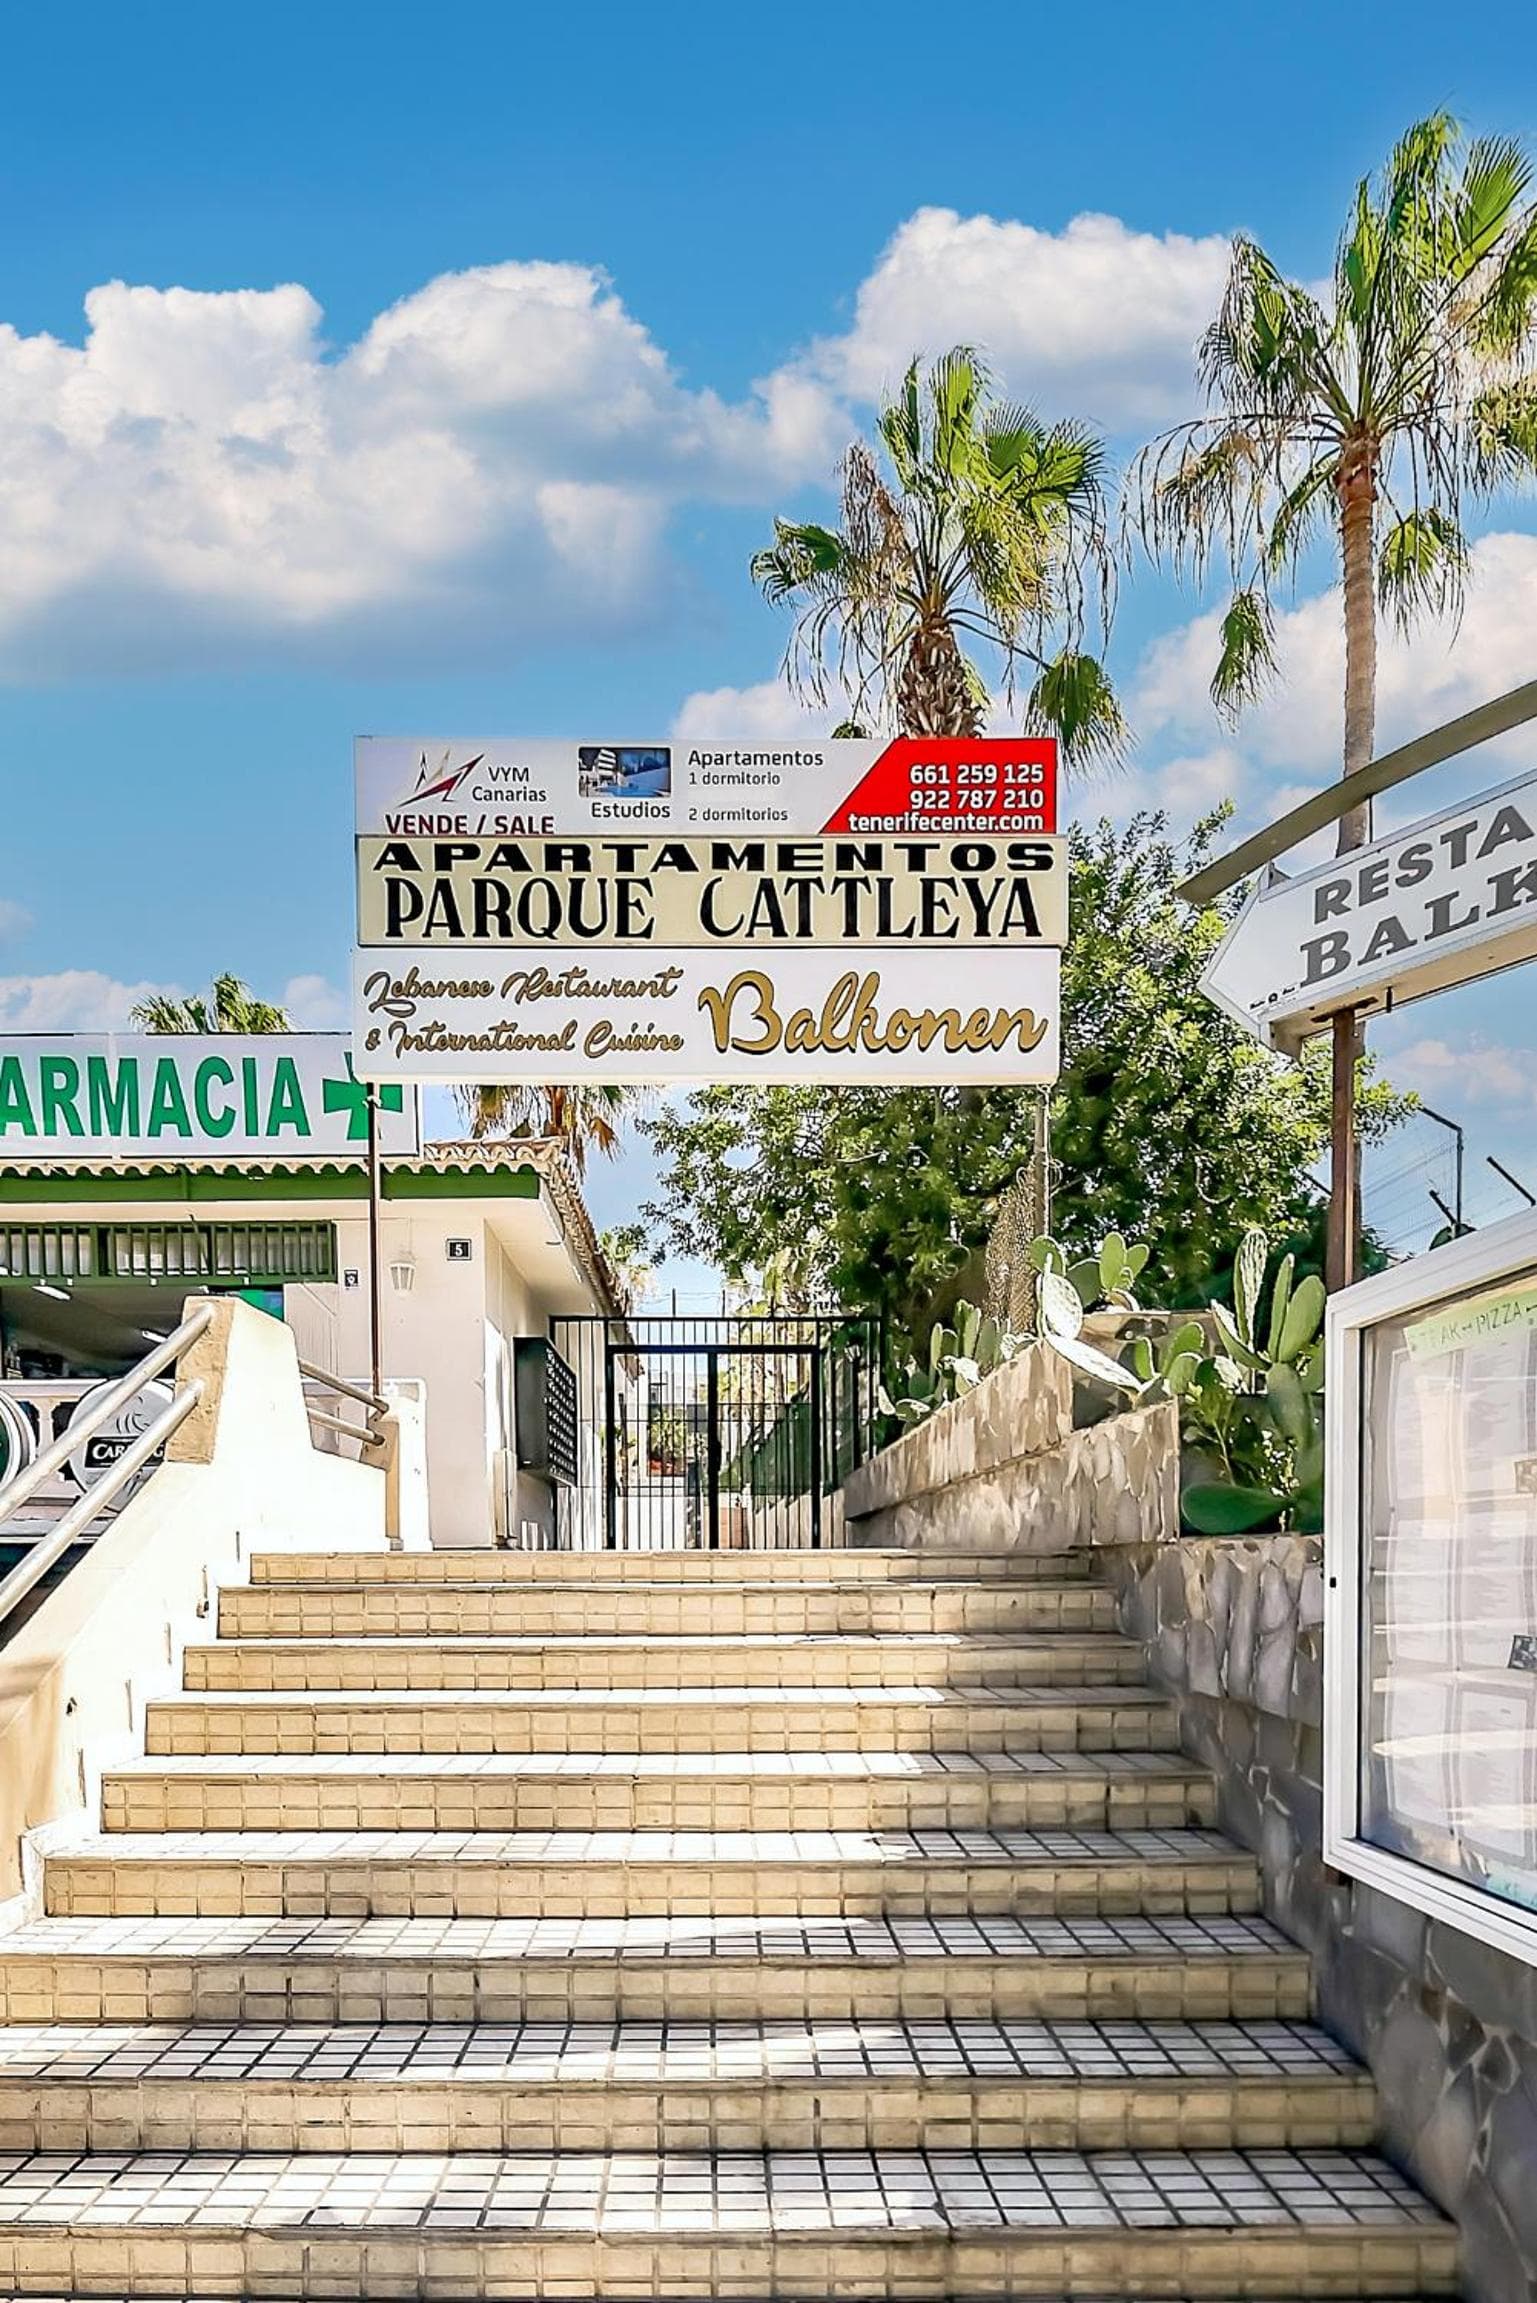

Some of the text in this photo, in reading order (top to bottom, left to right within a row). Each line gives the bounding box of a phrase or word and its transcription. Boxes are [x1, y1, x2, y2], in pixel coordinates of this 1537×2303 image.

[688, 750, 824, 768] Apartamentos
[488, 767, 530, 782] VYM
[689, 771, 781, 786] 1 dormitorio
[909, 764, 1044, 784] 661 259 125
[472, 786, 547, 802] Canarias
[909, 790, 1044, 809] 922 787 210
[591, 802, 671, 818] Estudios
[689, 807, 789, 822] 2 dormitorios
[385, 814, 468, 834] VENDE
[494, 814, 554, 834] SALE
[848, 811, 1044, 832] tenerifecenter.com
[373, 842, 1055, 872] APARTAMENTOS
[1314, 805, 1535, 925] RESTA
[384, 876, 1043, 941] PARQUE CATTLEYA
[1300, 859, 1537, 988] BALK
[364, 966, 684, 1018] Lebanese Restaurant
[697, 970, 1050, 1055] Balkonen
[365, 1019, 684, 1059] & International Cuisine
[0, 1055, 312, 1138] ARMACIA
[1476, 1301, 1522, 1335] PIZZA
[92, 1443, 164, 1459] CARG
